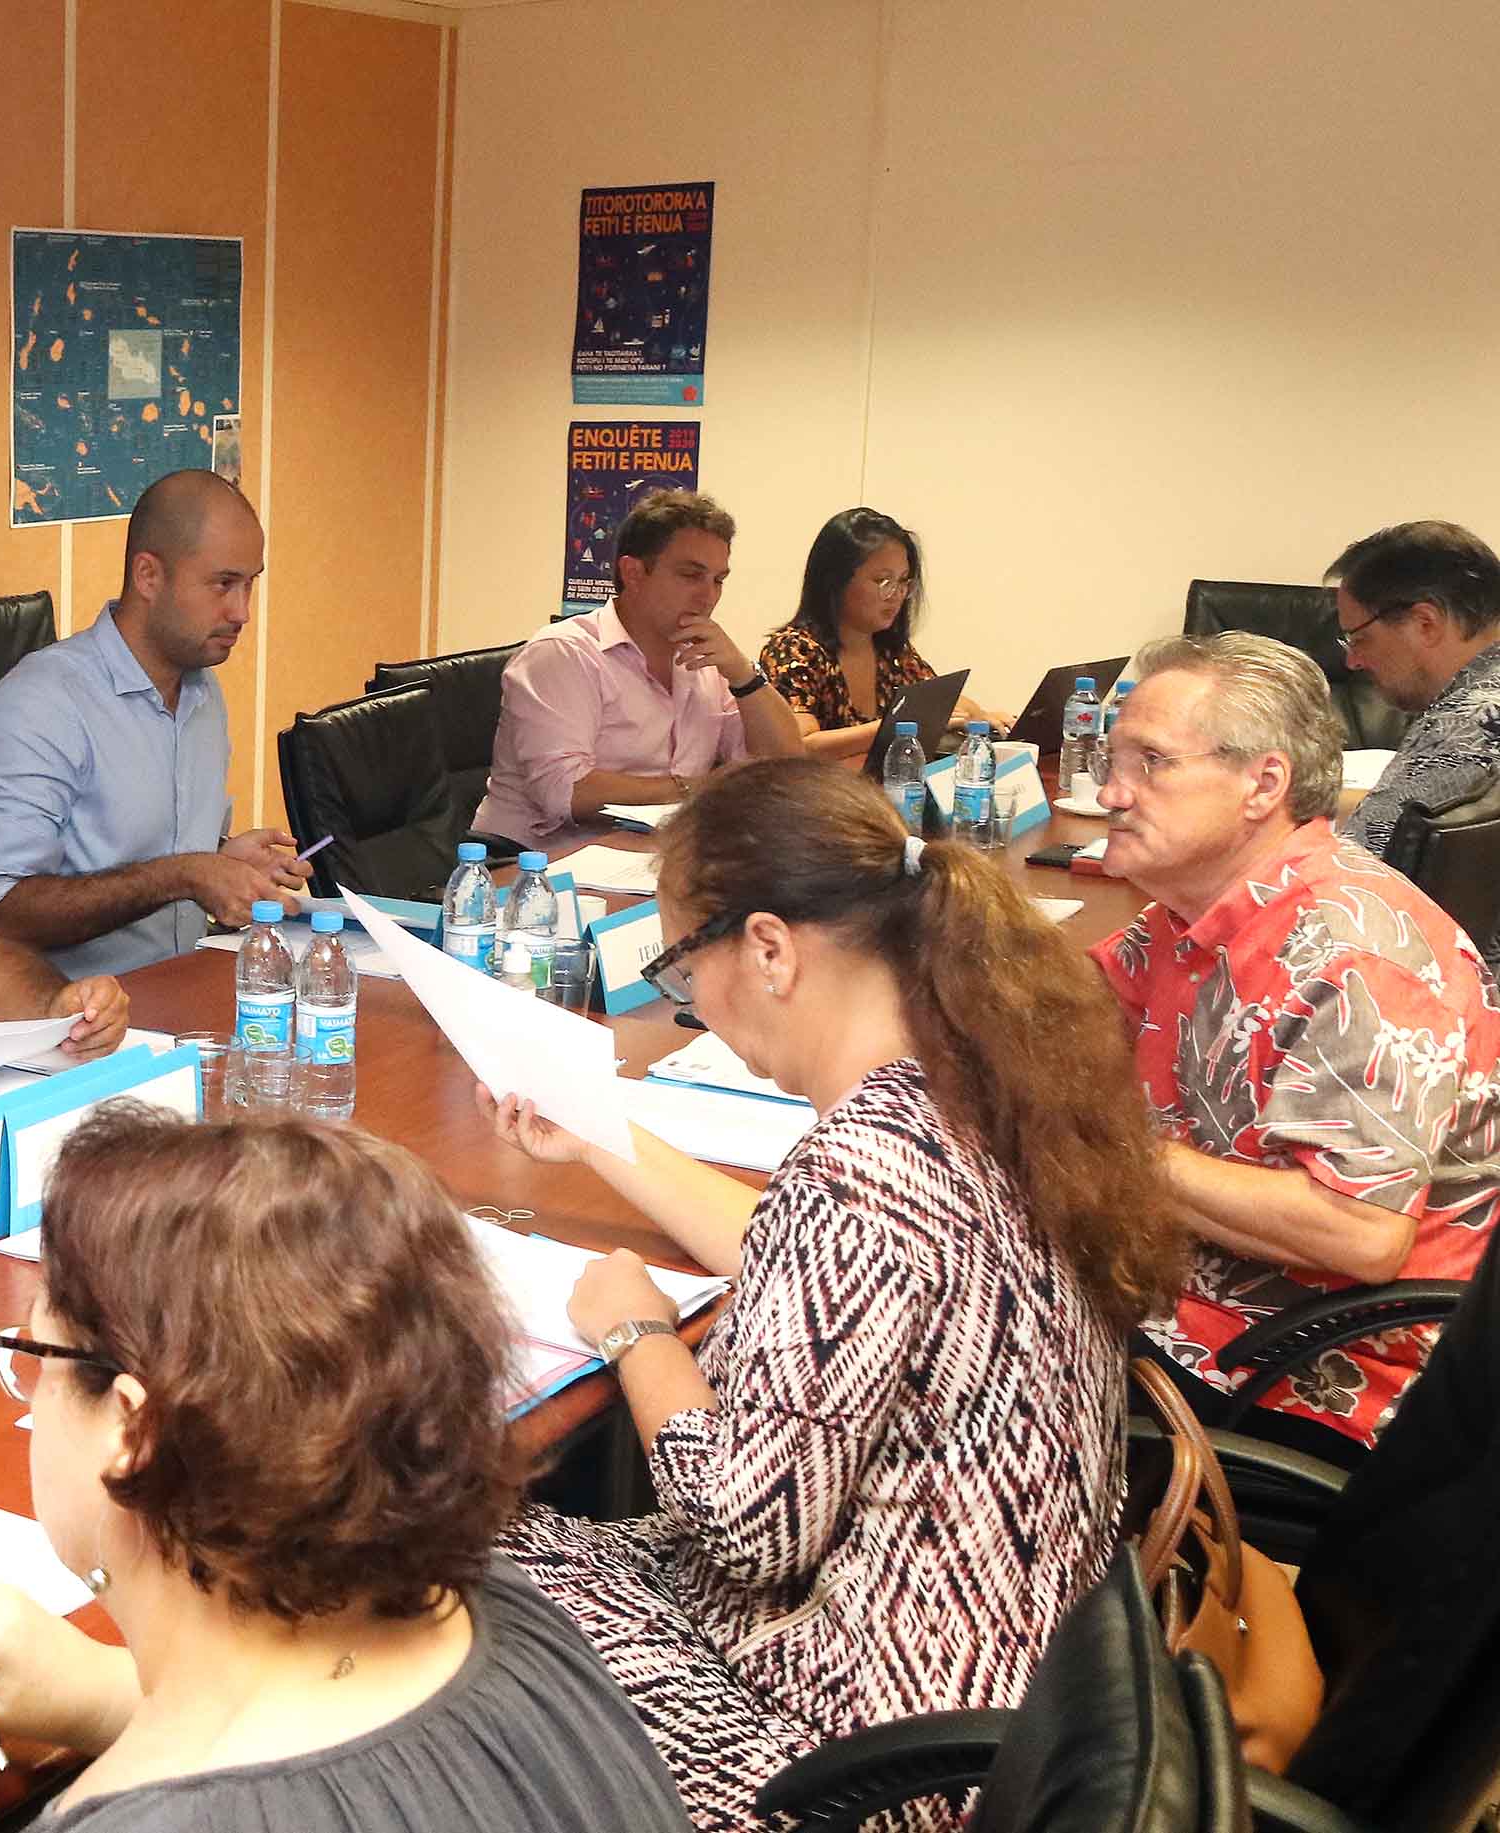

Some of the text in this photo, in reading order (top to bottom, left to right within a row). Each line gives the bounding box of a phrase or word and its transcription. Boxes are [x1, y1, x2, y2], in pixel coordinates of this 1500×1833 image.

[635, 212, 684, 234] FENUA
[572, 424, 663, 448] ENQUÊTE
[619, 451, 629, 470] E
[633, 451, 693, 472] FENUA
